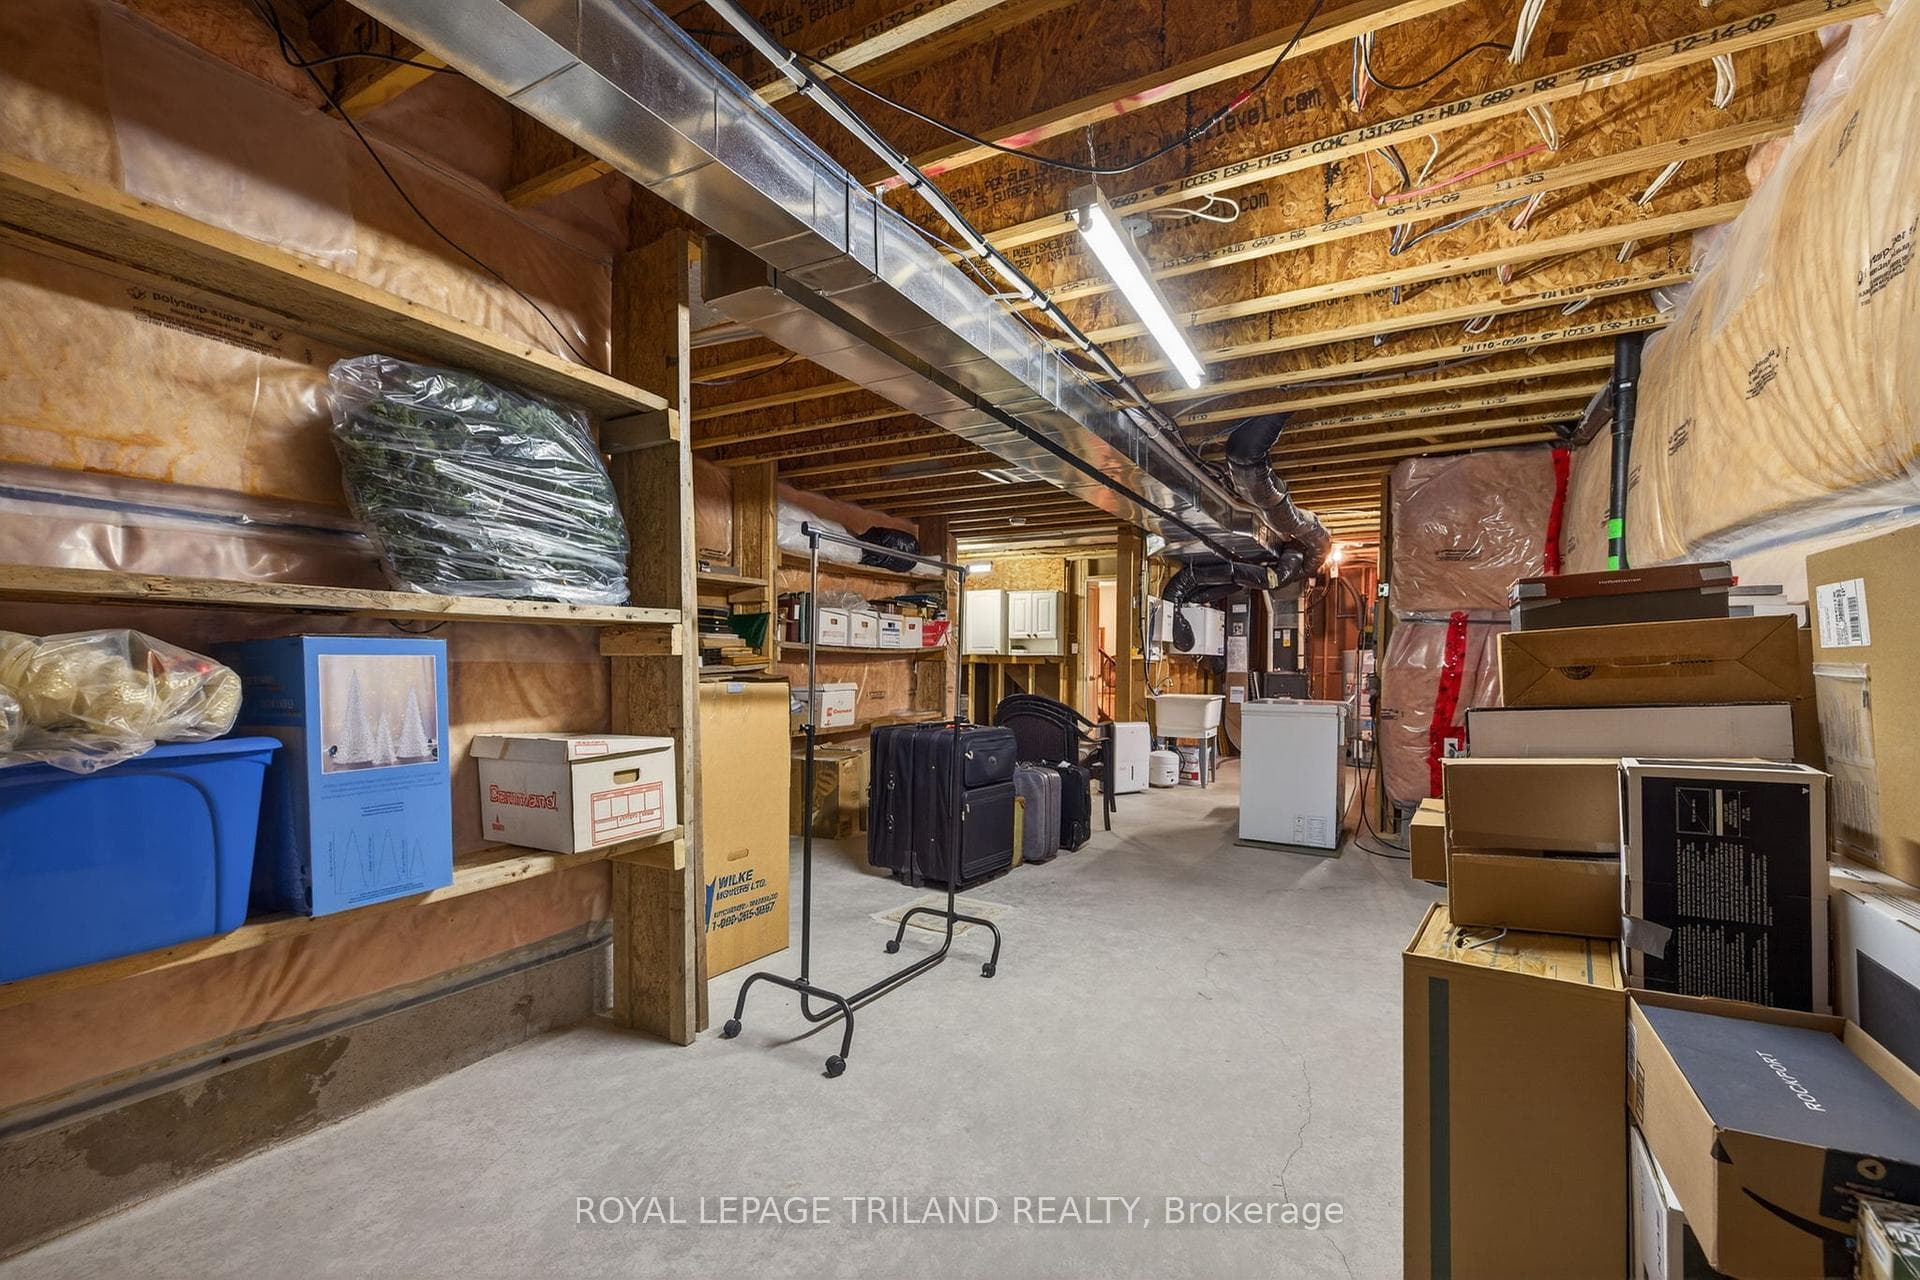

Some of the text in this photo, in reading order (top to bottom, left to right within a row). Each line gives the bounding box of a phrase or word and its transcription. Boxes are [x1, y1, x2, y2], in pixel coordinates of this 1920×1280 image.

[1311, 133, 1350, 154] CCMC
[1358, 113, 1424, 142] 13132-R
[1439, 101, 1473, 120] HUD
[1671, 12, 1777, 55] 12-14-09
[152, 291, 208, 314] polytarp
[210, 308, 247, 326] super
[718, 869, 753, 889] WILKE
[1755, 1050, 1826, 1112] ROCKPORT
